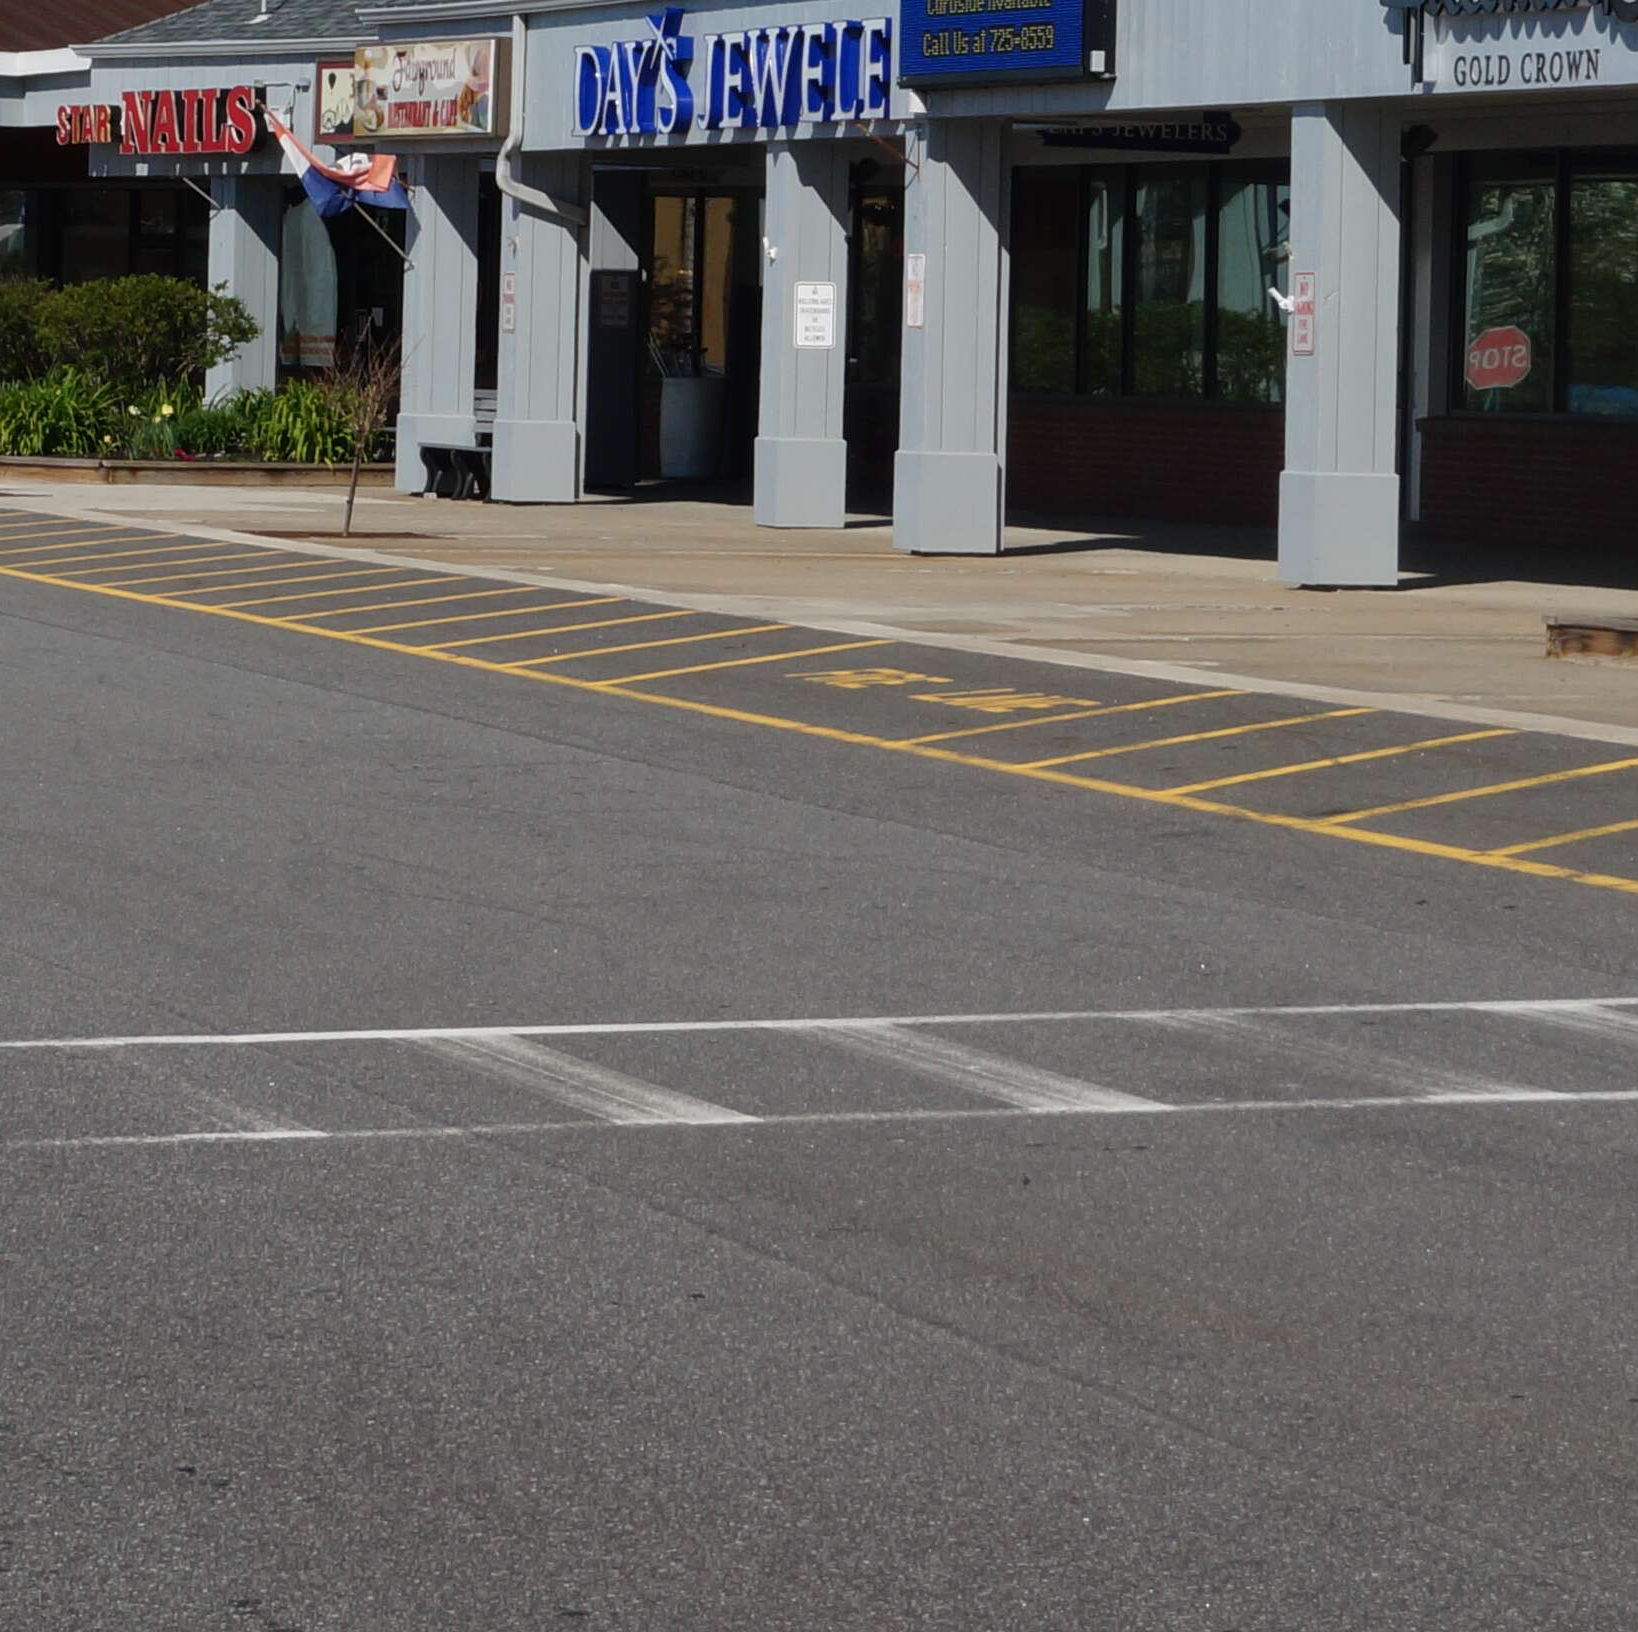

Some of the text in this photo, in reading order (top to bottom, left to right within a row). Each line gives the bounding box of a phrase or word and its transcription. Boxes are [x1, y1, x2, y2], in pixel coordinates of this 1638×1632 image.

[923, 25, 1054, 56] Call Us at 725-8559
[392, 48, 457, 97] Fairground
[571, 10, 694, 137] DAY'S
[1453, 49, 1601, 86] GOLD CROWN
[56, 84, 257, 155] STAR NAILS
